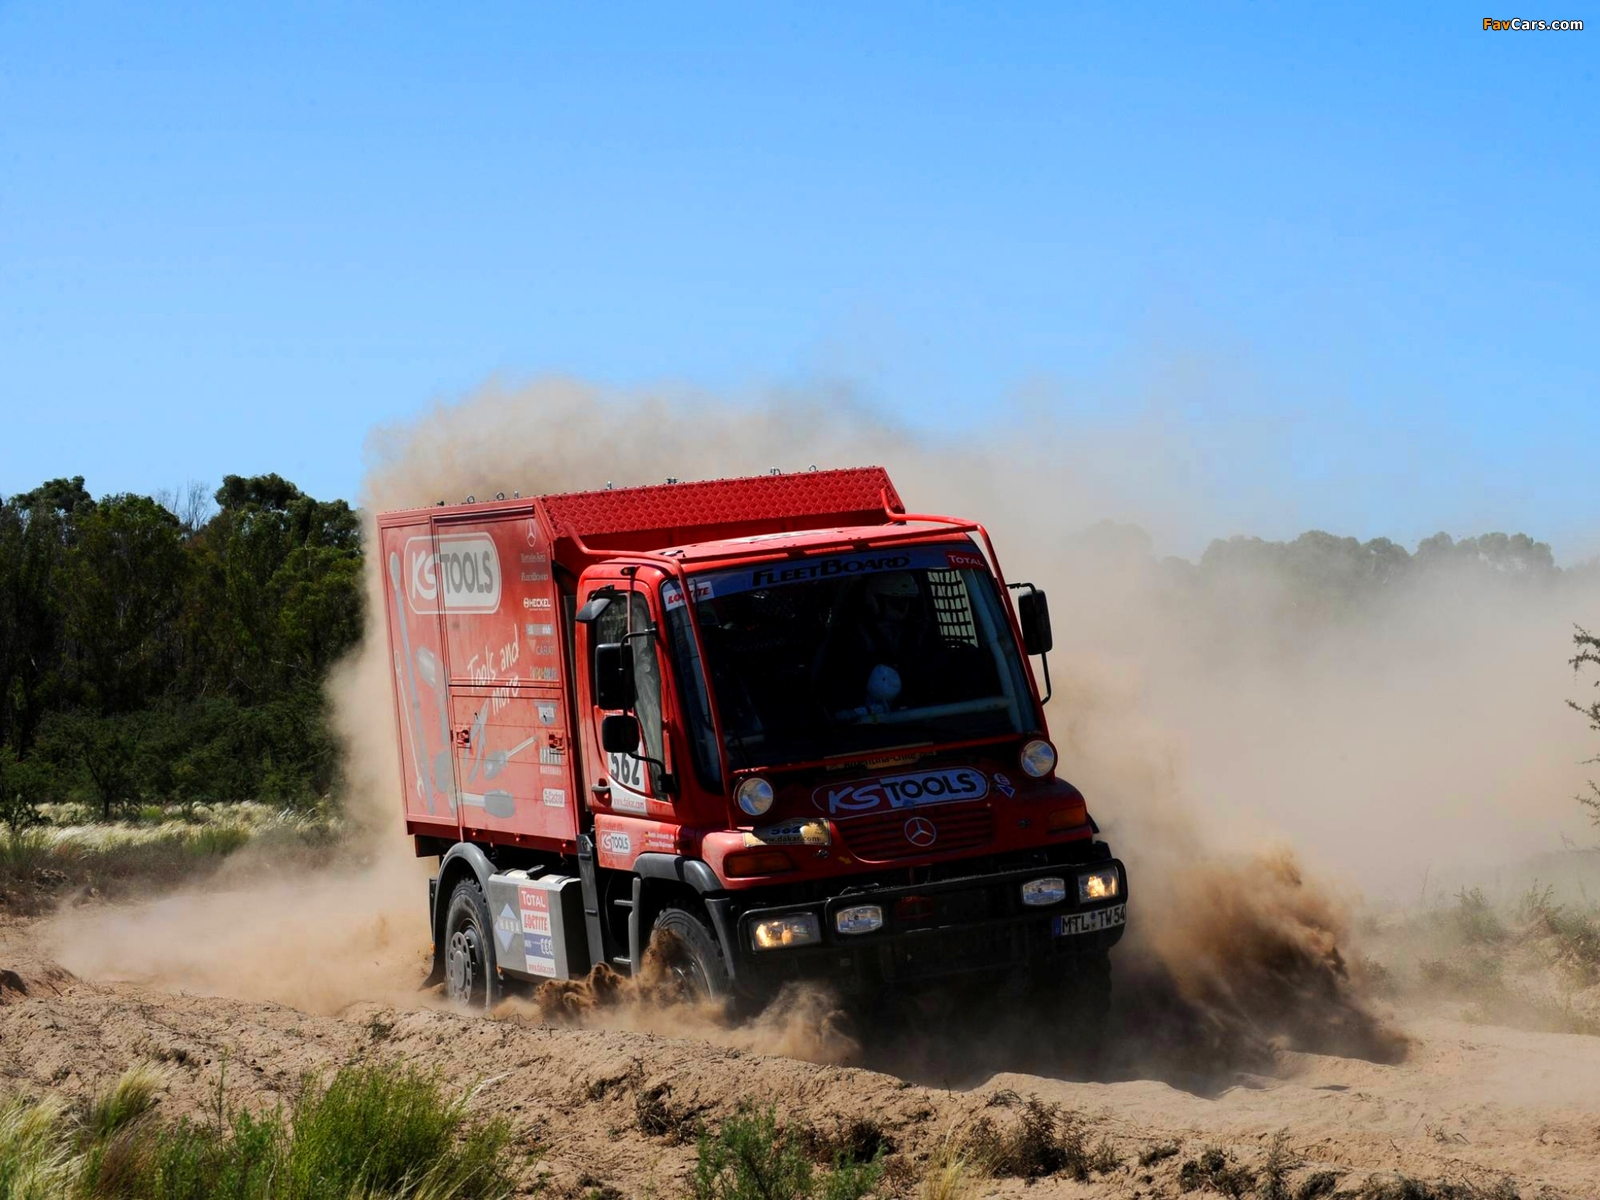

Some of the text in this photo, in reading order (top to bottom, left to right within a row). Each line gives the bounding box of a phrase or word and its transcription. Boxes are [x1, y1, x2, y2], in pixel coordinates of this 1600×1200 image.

[948, 555, 983, 566] TOTAL
[529, 598, 550, 607] HECKEL
[500, 623, 519, 672] and
[880, 773, 977, 801] TOOLS
[521, 891, 546, 908] TOTAL
[524, 914, 547, 931] LOCTITE
[1062, 915, 1090, 933] MTL
